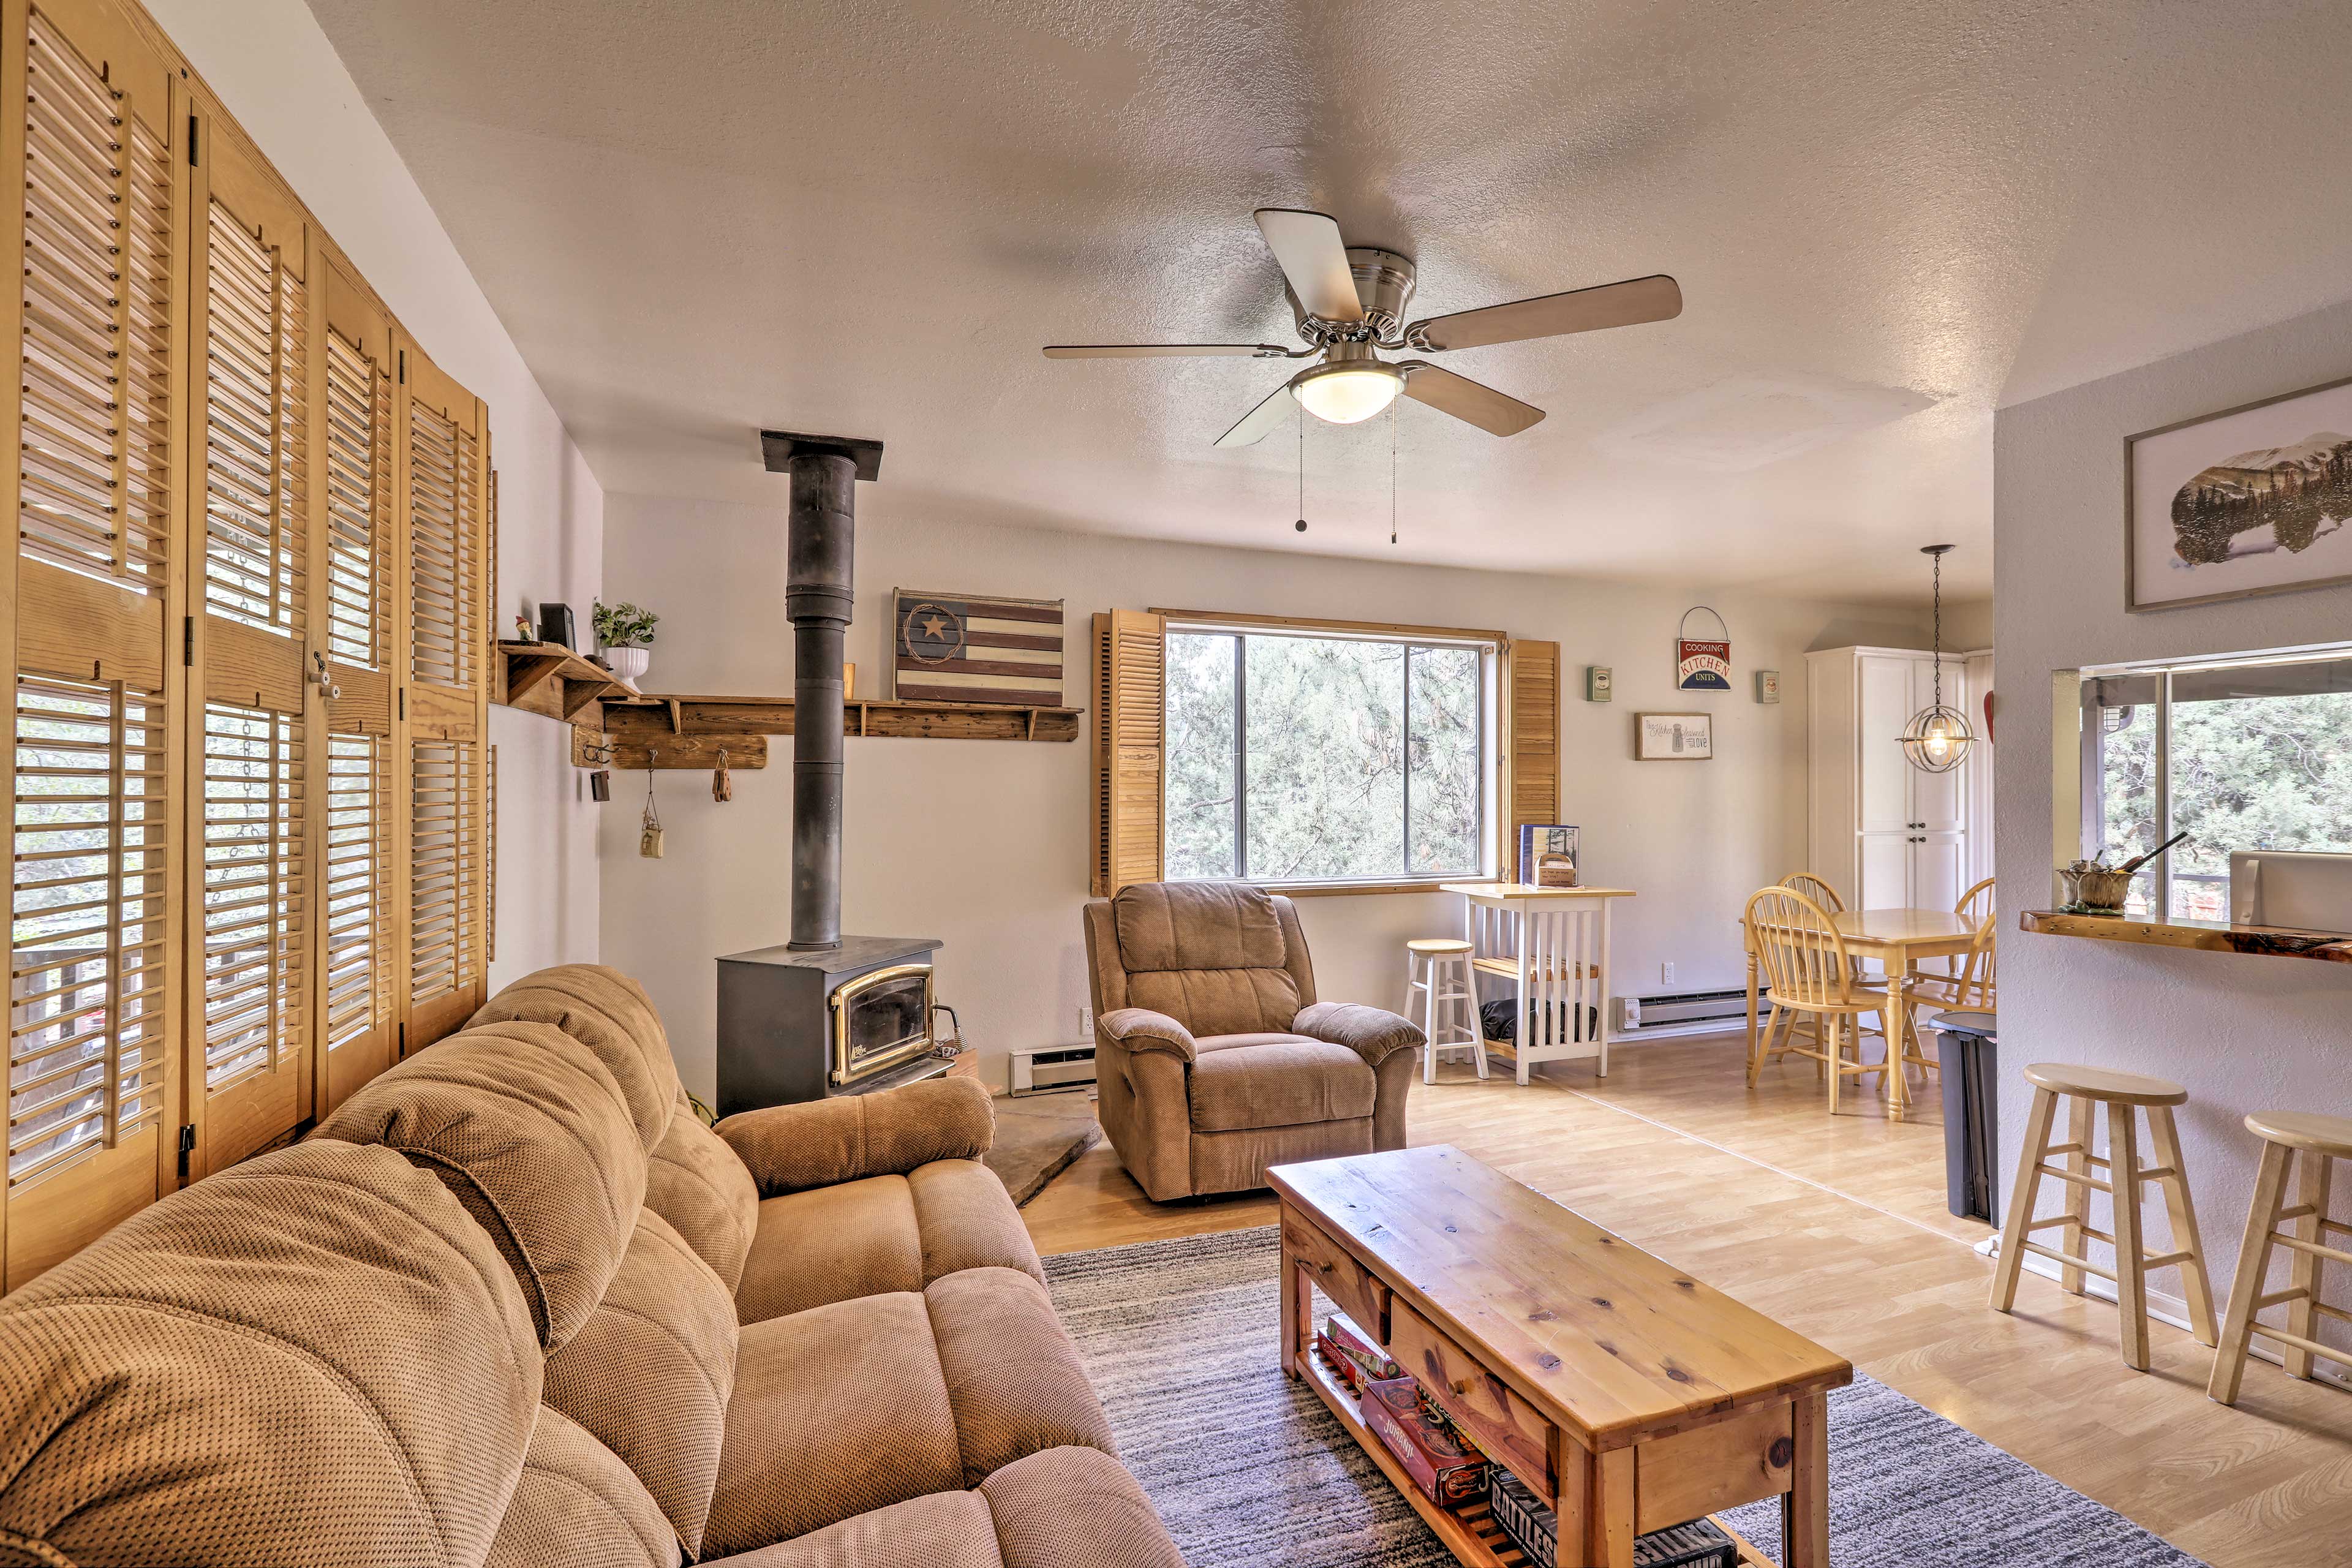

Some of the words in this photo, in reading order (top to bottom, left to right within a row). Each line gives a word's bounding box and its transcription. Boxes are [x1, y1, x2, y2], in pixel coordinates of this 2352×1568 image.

[1686, 644, 1724, 652] COOKING
[1681, 657, 1730, 676] KITCHEN
[1384, 1419, 1414, 1458] JUMANJI
[1503, 1523, 1522, 1545] CLASSIC
[1523, 1544, 1538, 1562] NAVAL
